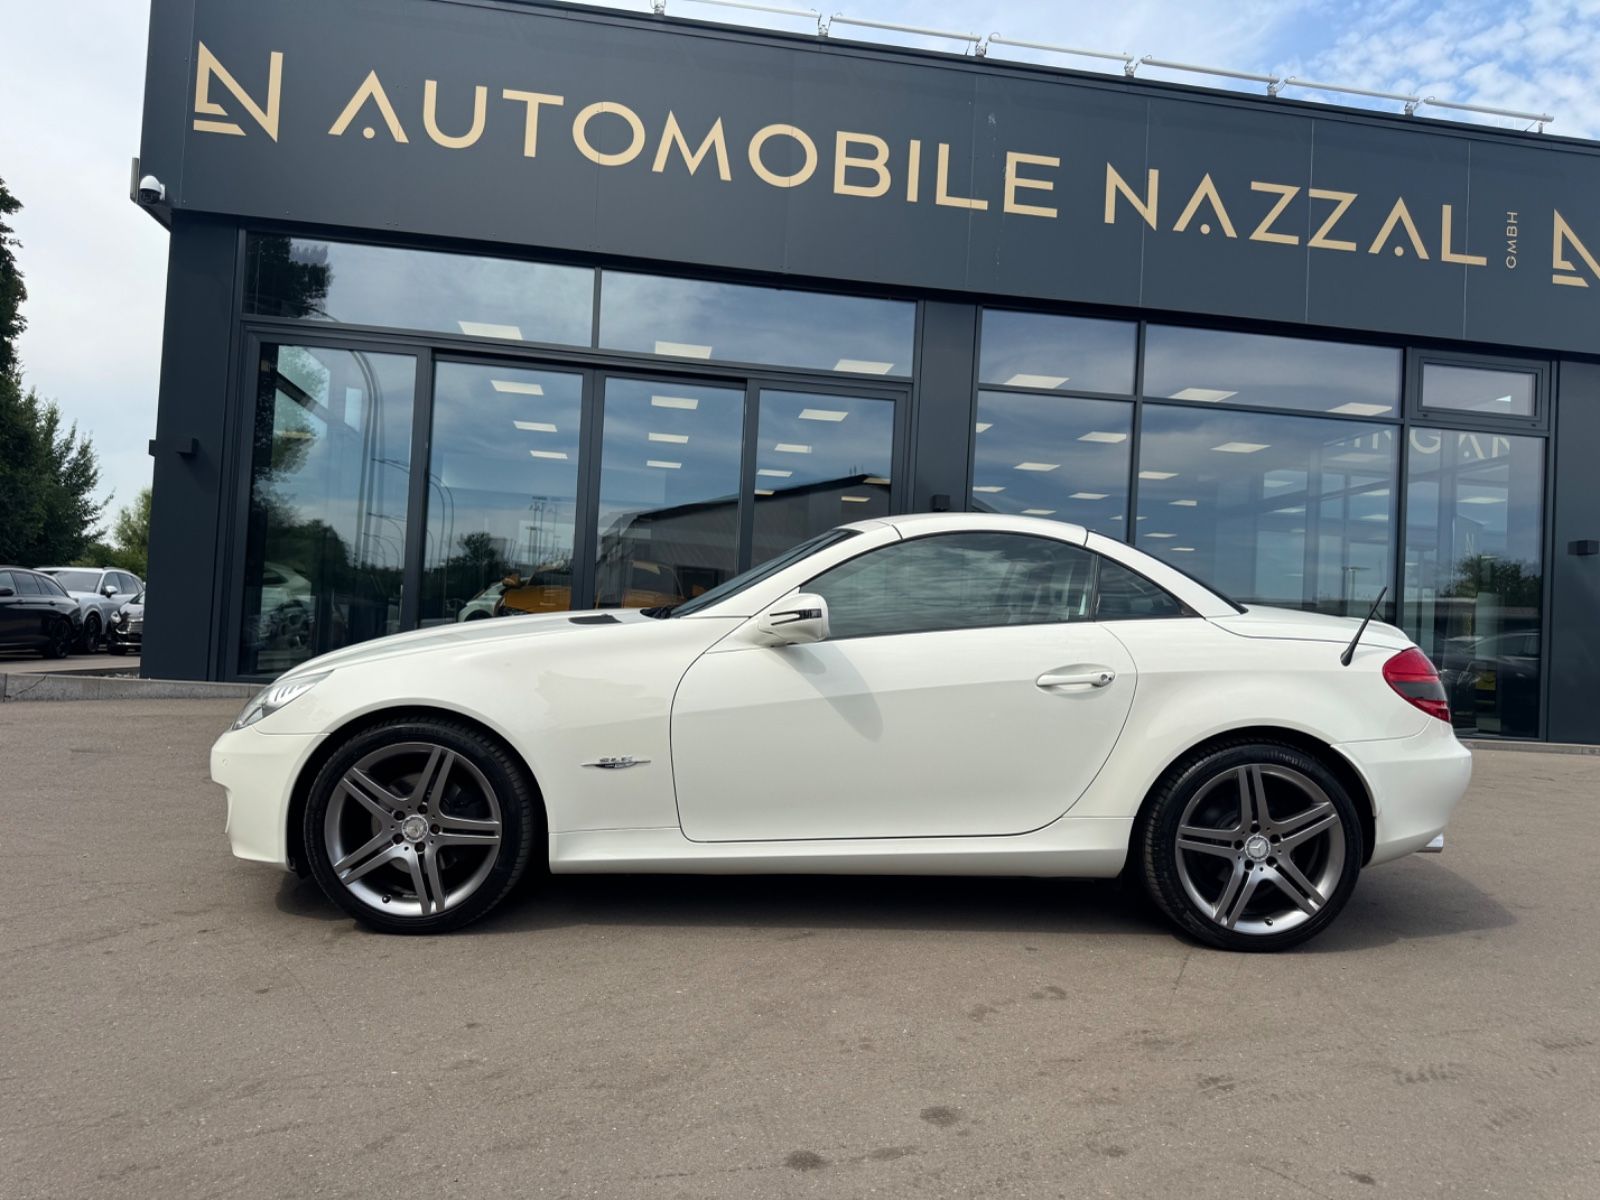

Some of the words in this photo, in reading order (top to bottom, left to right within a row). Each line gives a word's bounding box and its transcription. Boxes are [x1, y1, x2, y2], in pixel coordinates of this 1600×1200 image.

[328, 69, 1062, 218] AUTOMOBILE
[1104, 162, 1488, 267] NAZZAL
[1505, 211, 1518, 269] GMBH
